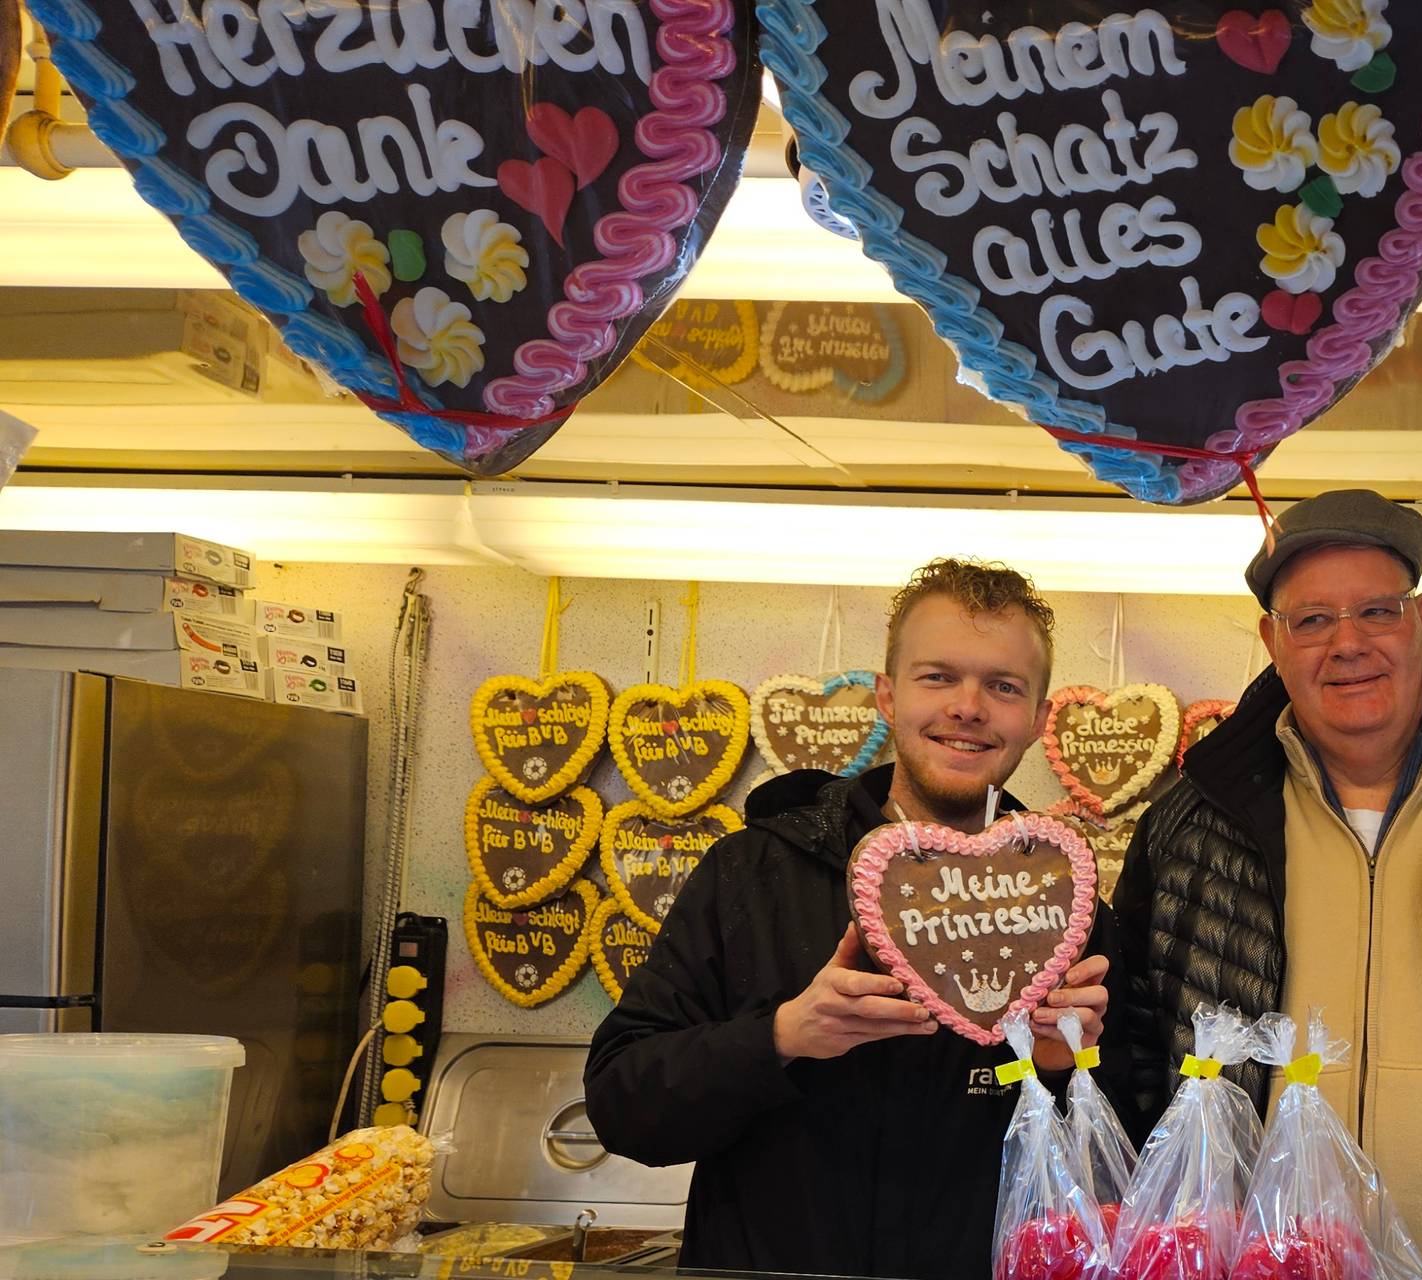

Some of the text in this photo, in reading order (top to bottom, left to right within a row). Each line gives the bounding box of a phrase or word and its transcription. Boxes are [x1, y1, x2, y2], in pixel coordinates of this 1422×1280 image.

[848, 0, 1187, 119] Meinem
[187, 83, 501, 216] Dank
[890, 88, 1198, 217] Schatz
[971, 195, 1202, 297] alles
[1039, 275, 1271, 391] Gute
[767, 698, 878, 724] Für unseren
[794, 724, 859, 745] Prinzen
[1060, 731, 1159, 759] Prinzessin
[671, 831, 719, 852] schlä
[931, 866, 1038, 902] Meine
[899, 894, 1068, 946] Prinzessin
[967, 1087, 987, 1095] MEIN
